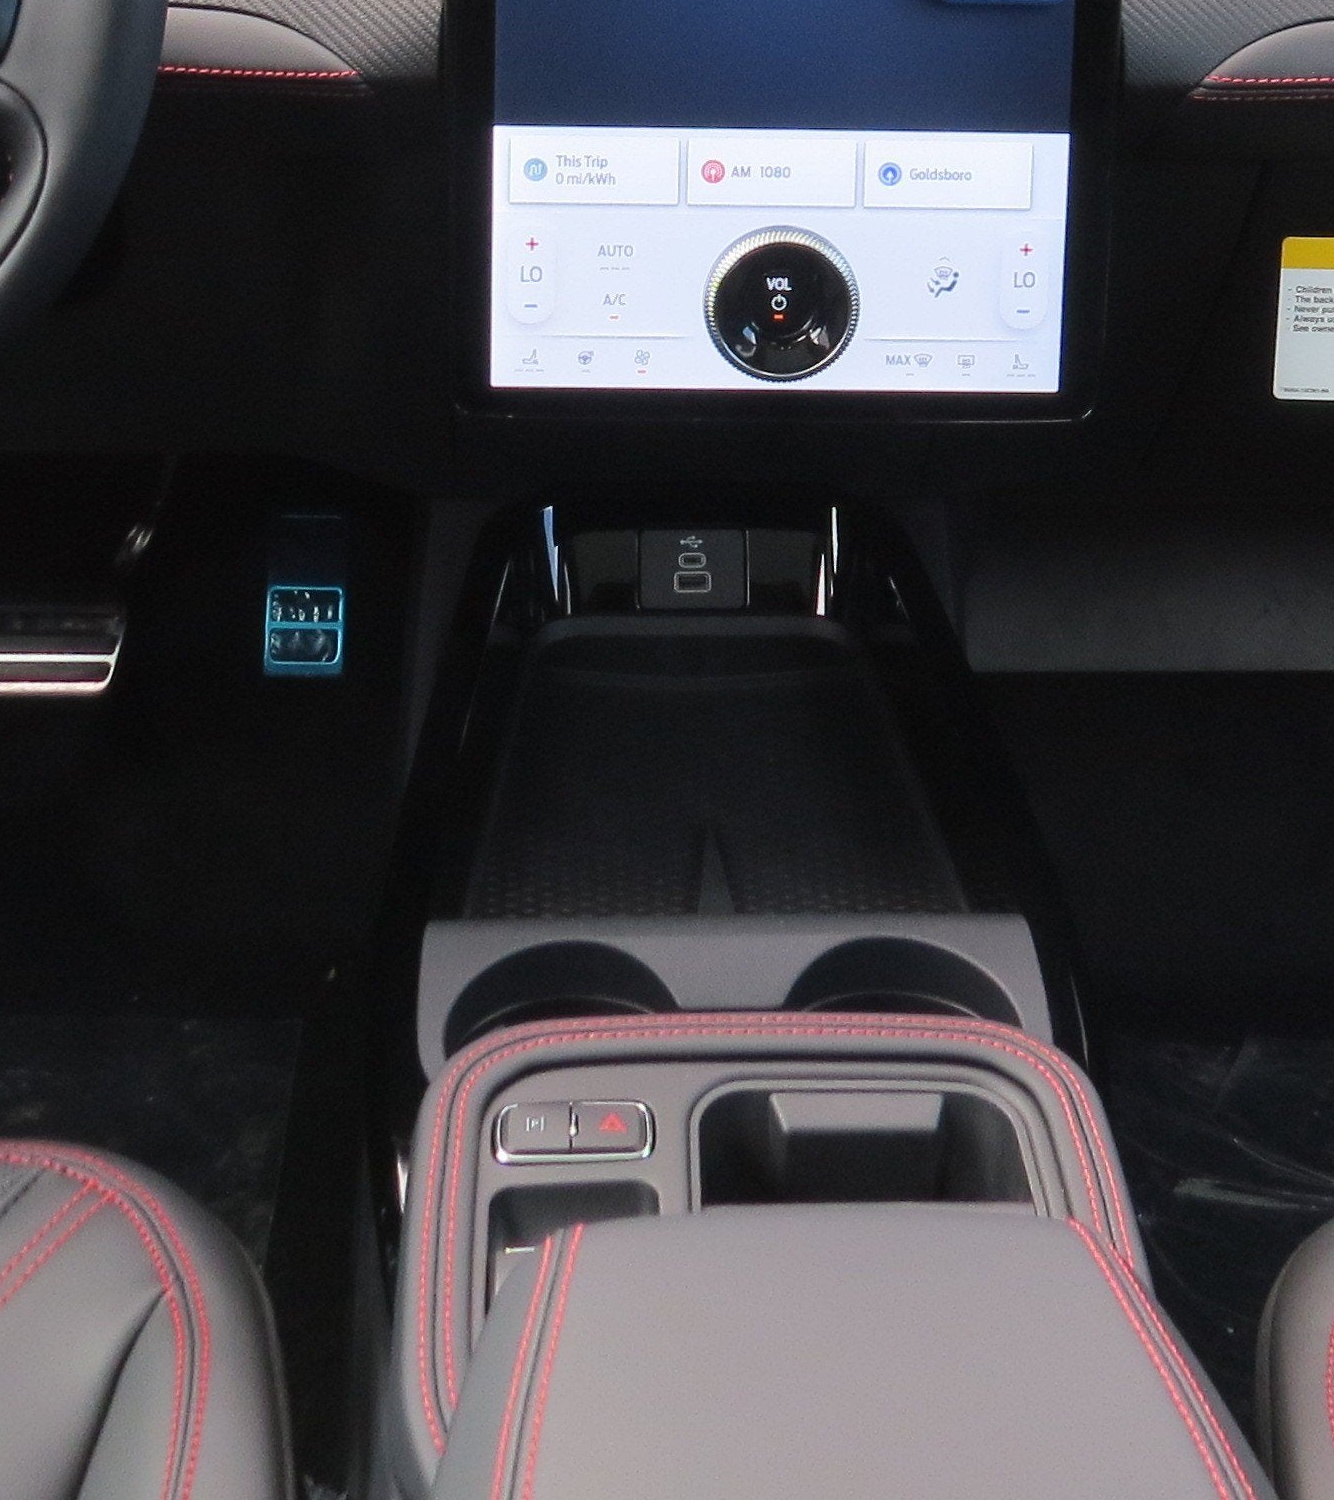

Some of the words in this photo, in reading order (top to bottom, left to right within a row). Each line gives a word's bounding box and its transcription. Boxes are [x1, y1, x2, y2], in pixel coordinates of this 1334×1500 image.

[555, 154, 579, 169] This
[581, 154, 609, 172] Trip
[554, 172, 563, 186] 0
[565, 170, 617, 187] mi/kWh
[730, 165, 752, 179] AM
[759, 165, 791, 180] 1080
[909, 167, 973, 184] Goldsboro
[597, 243, 634, 259] AUTO
[519, 264, 543, 284] LO
[1013, 271, 1036, 289] LO
[766, 276, 792, 291] VOL
[1295, 285, 1332, 295] Children
[602, 292, 627, 308] A/C
[1295, 295, 1311, 304] The
[1313, 295, 1333, 304] back
[1293, 315, 1325, 324] Always
[1293, 324, 1309, 332] See
[885, 354, 912, 366] MAX
